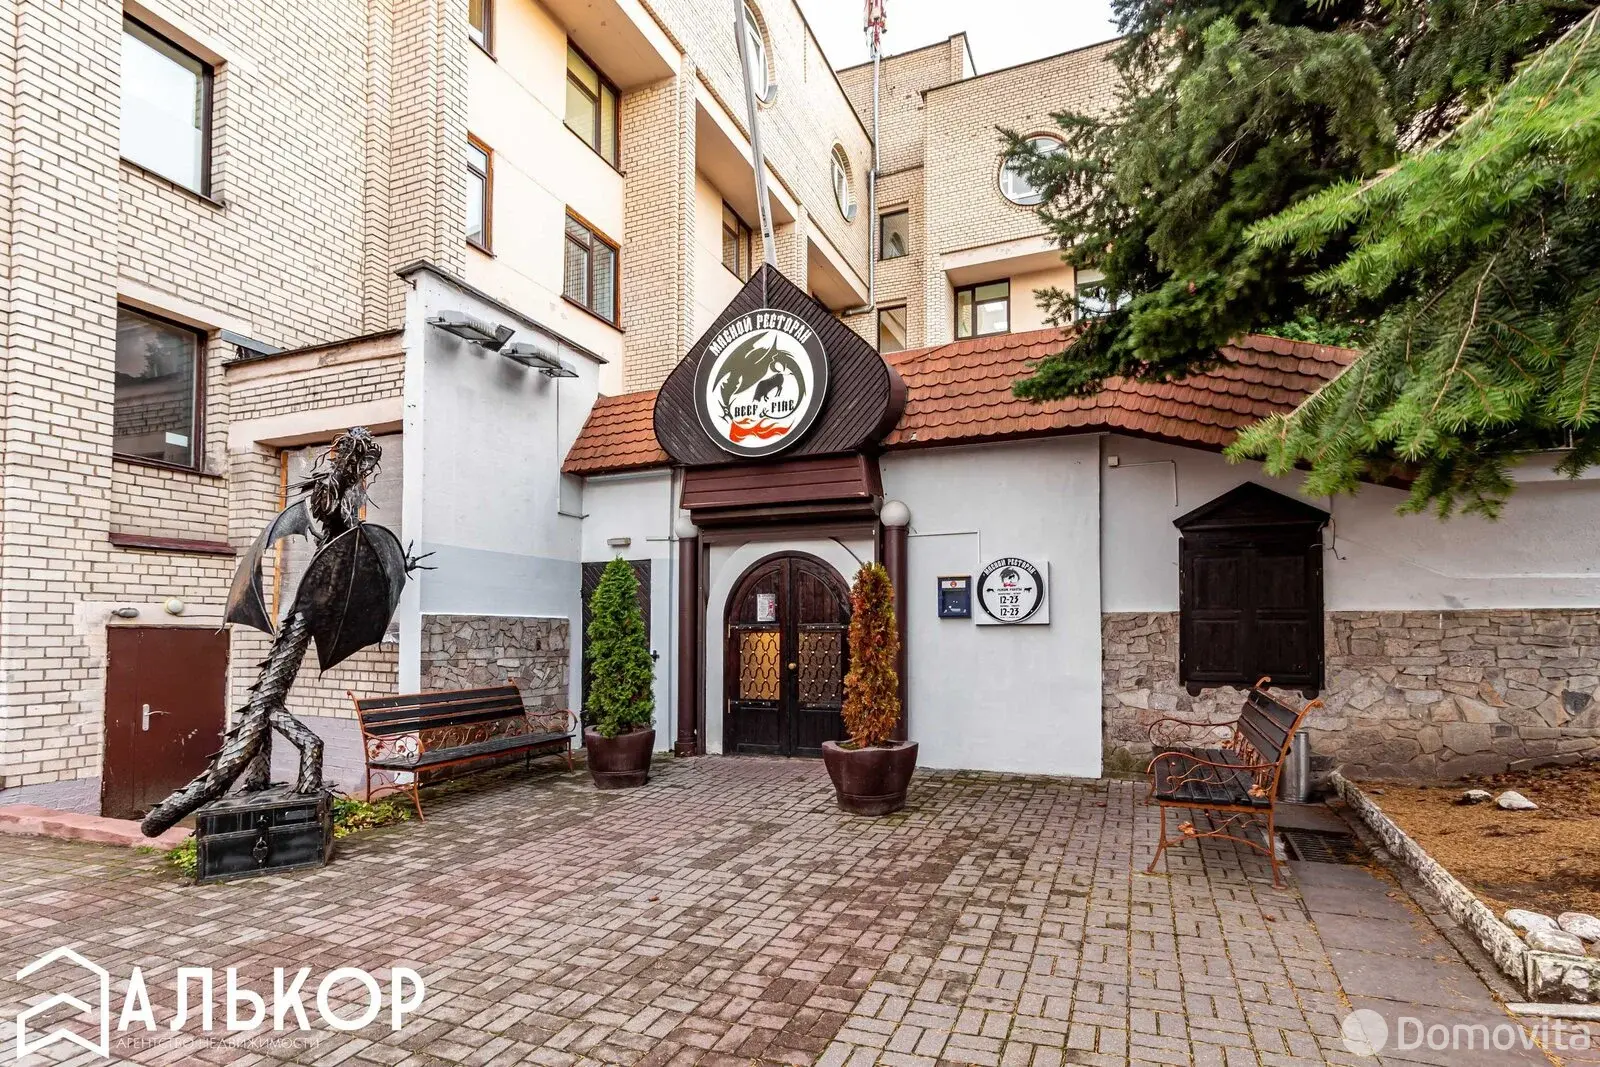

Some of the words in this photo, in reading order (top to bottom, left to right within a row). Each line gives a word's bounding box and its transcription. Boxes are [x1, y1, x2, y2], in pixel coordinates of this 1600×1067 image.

[709, 315, 753, 357] МЯСНОЙ
[756, 312, 812, 344] РЕСТОРАН
[734, 405, 758, 418] BEEF
[771, 400, 795, 413] FIRE
[1000, 596, 1019, 604] 12-23
[1000, 608, 1019, 616] 12-23
